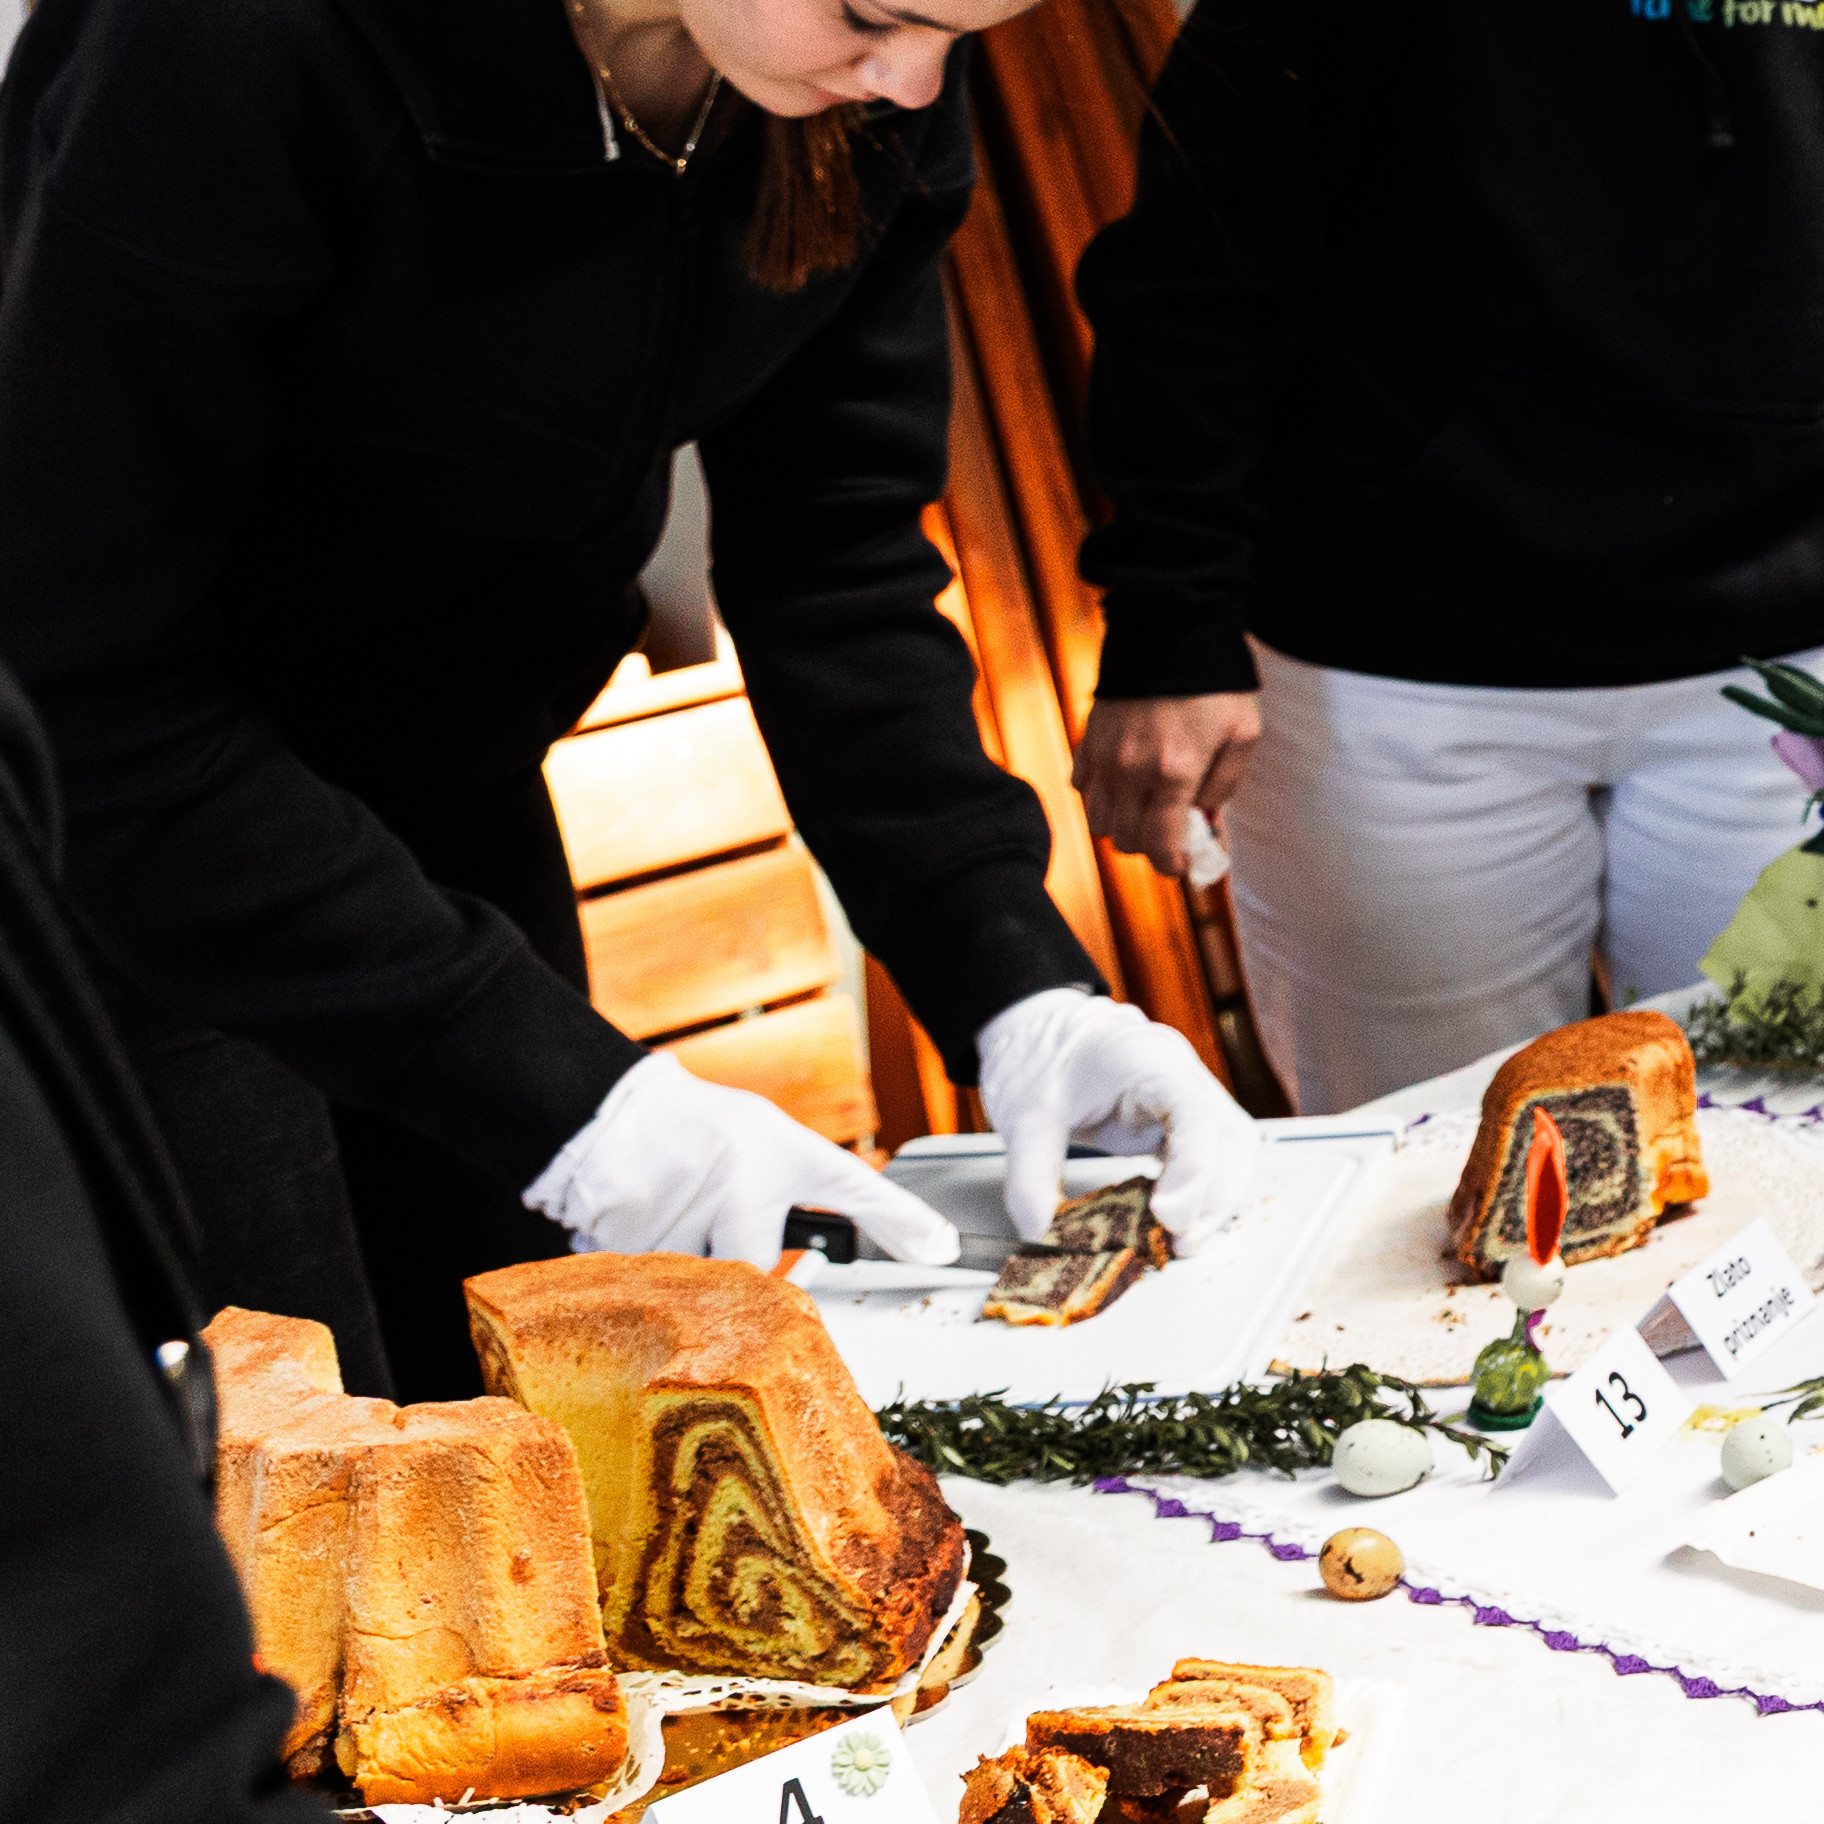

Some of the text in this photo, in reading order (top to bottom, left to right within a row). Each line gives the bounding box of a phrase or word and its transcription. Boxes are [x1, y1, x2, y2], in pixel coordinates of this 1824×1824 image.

[1705, 1256, 1751, 1298] Zlato
[1722, 1285, 1795, 1361] priznanje
[1595, 1371, 1648, 1440] 13
[779, 1777, 825, 1824] 4
